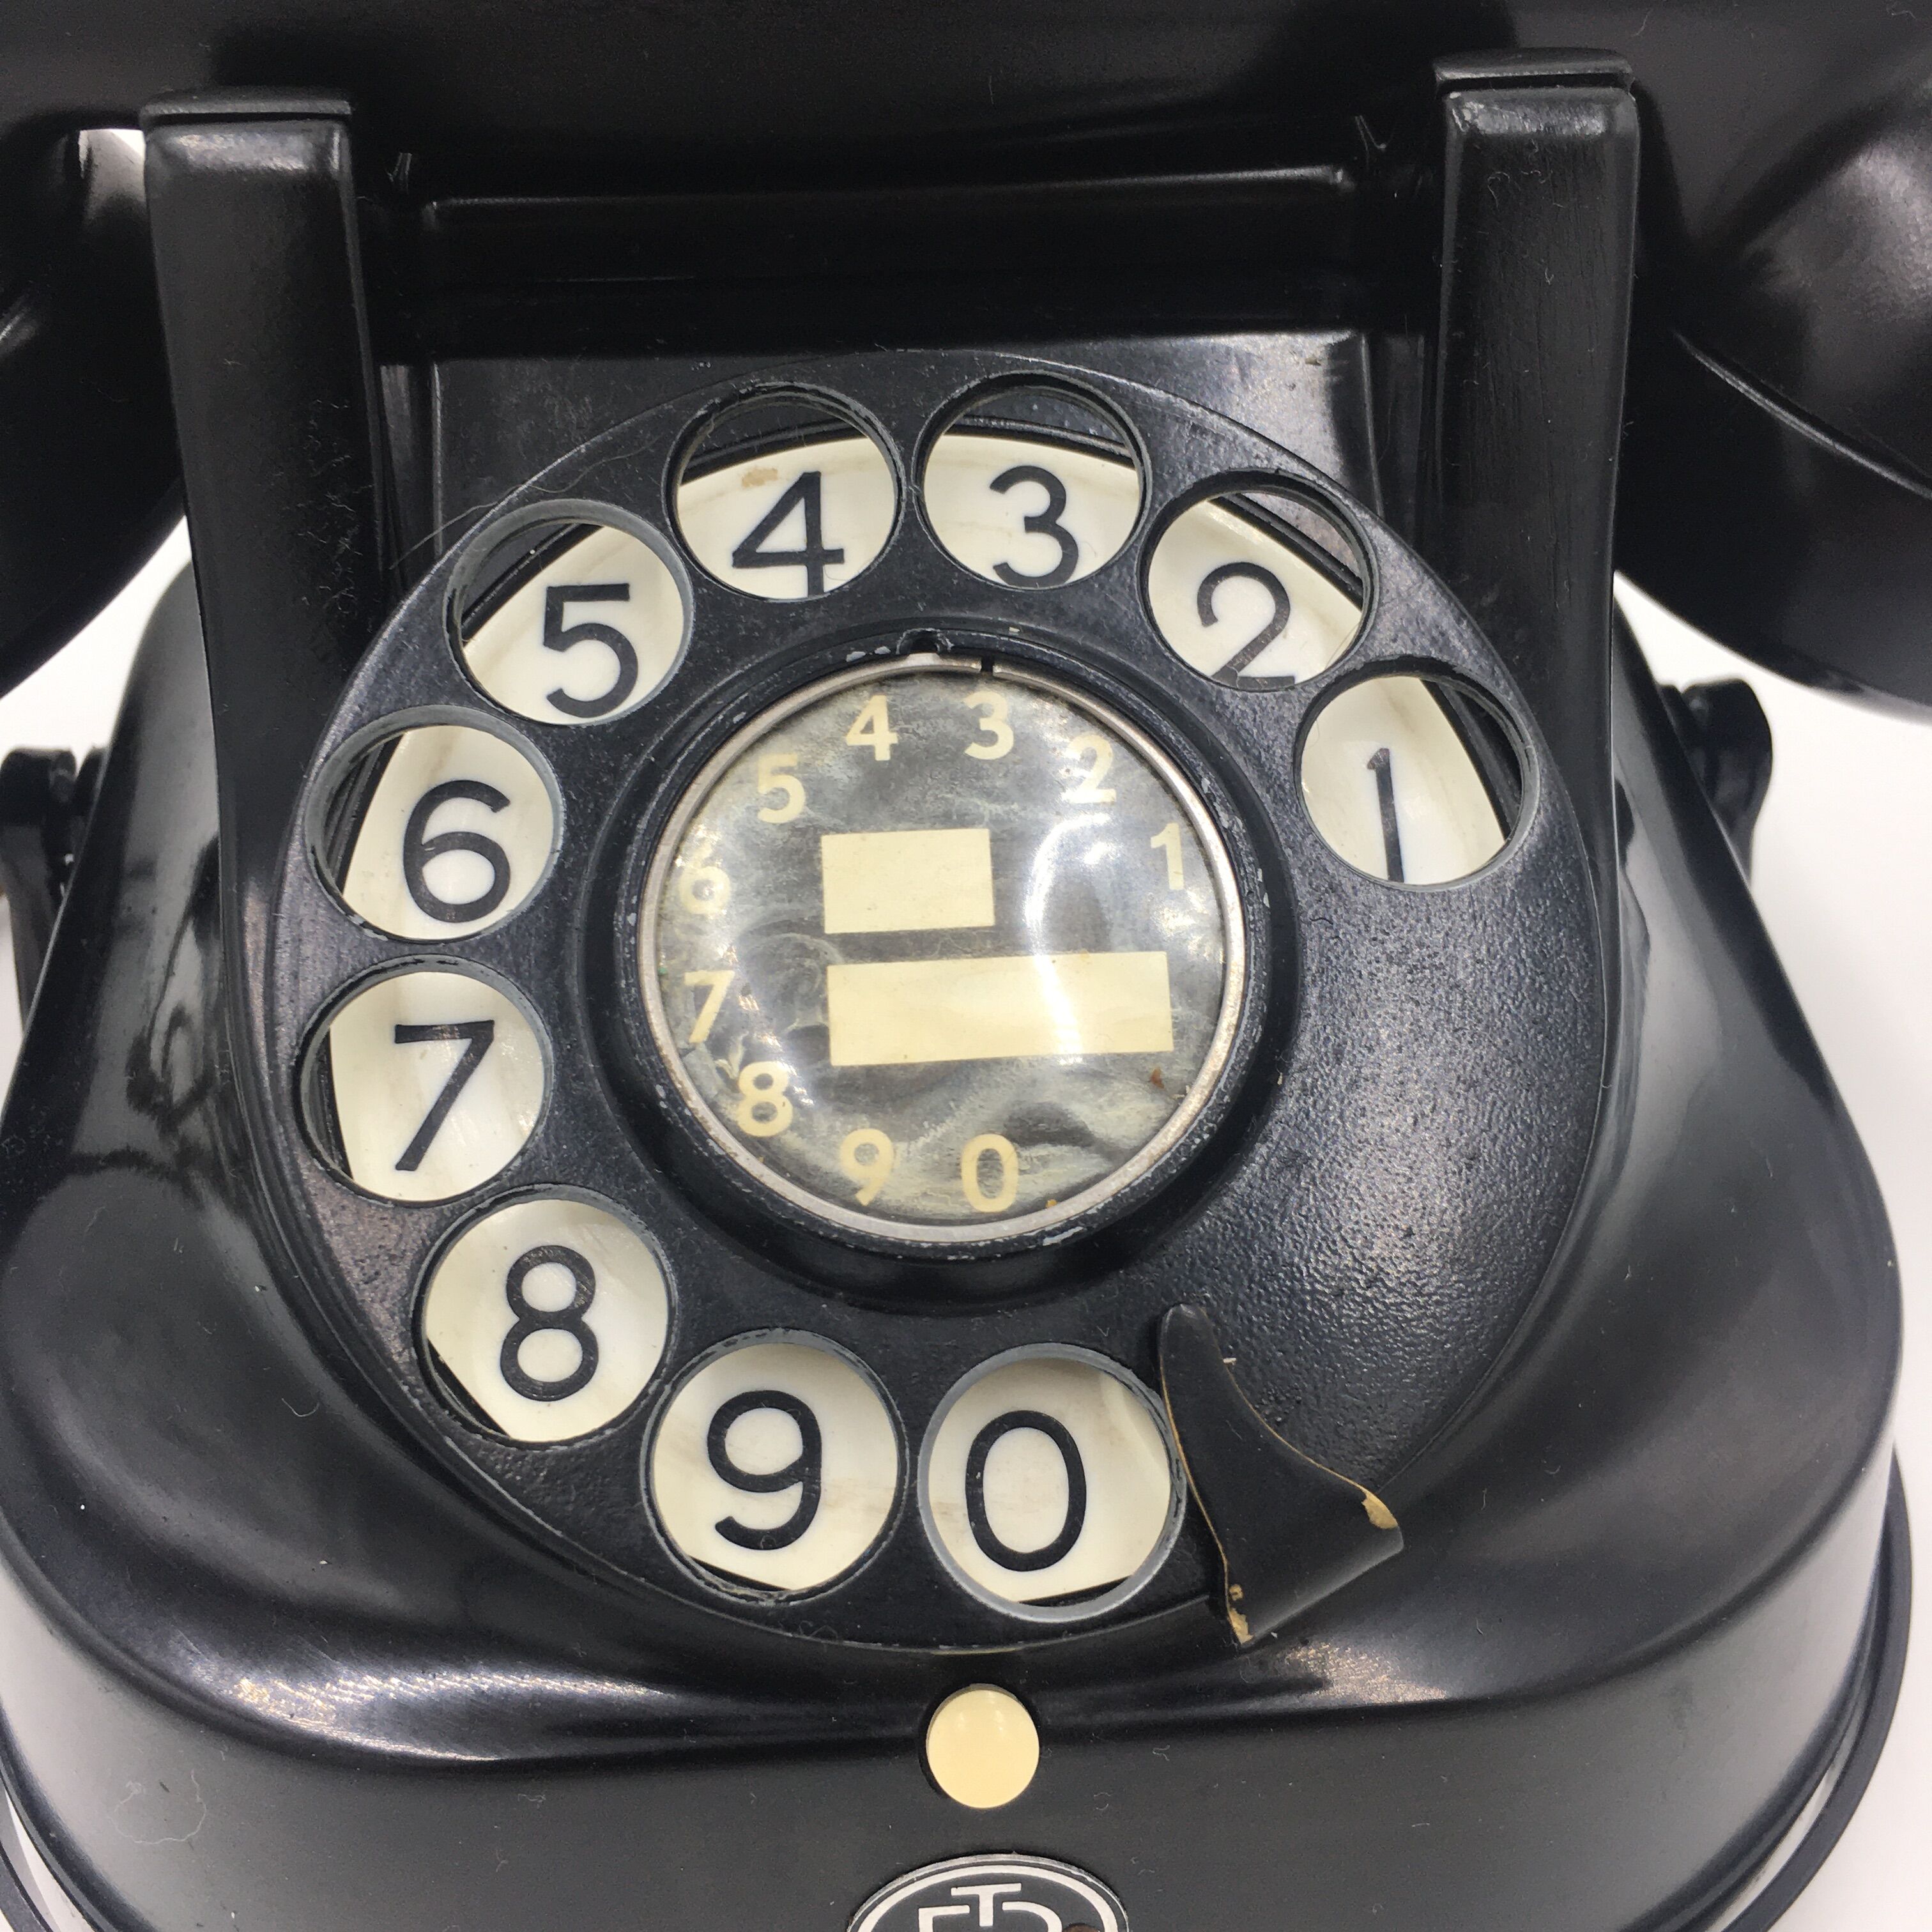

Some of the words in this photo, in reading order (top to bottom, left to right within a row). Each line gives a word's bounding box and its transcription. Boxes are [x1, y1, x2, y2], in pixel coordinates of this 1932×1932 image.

[732, 471, 845, 597] 4
[990, 466, 1079, 587] 3
[544, 583, 638, 718] 5
[1197, 562, 1295, 690] 2
[846, 694, 898, 761] 4
[963, 691, 1014, 760] 3
[1061, 735, 1116, 804] 2
[758, 755, 806, 824] 5
[1367, 747, 1404, 883] 1
[403, 779, 510, 923] 6
[679, 841, 731, 914] 6
[1150, 823, 1184, 891] 1
[684, 970, 735, 1044] 7
[394, 1019, 494, 1171] 7
[738, 1061, 793, 1137] 8
[839, 1129, 894, 1206] 9
[960, 1134, 1018, 1213] 0
[500, 1245, 599, 1402] 8
[707, 1390, 822, 1551] 9
[965, 1410, 1086, 1572] 0
